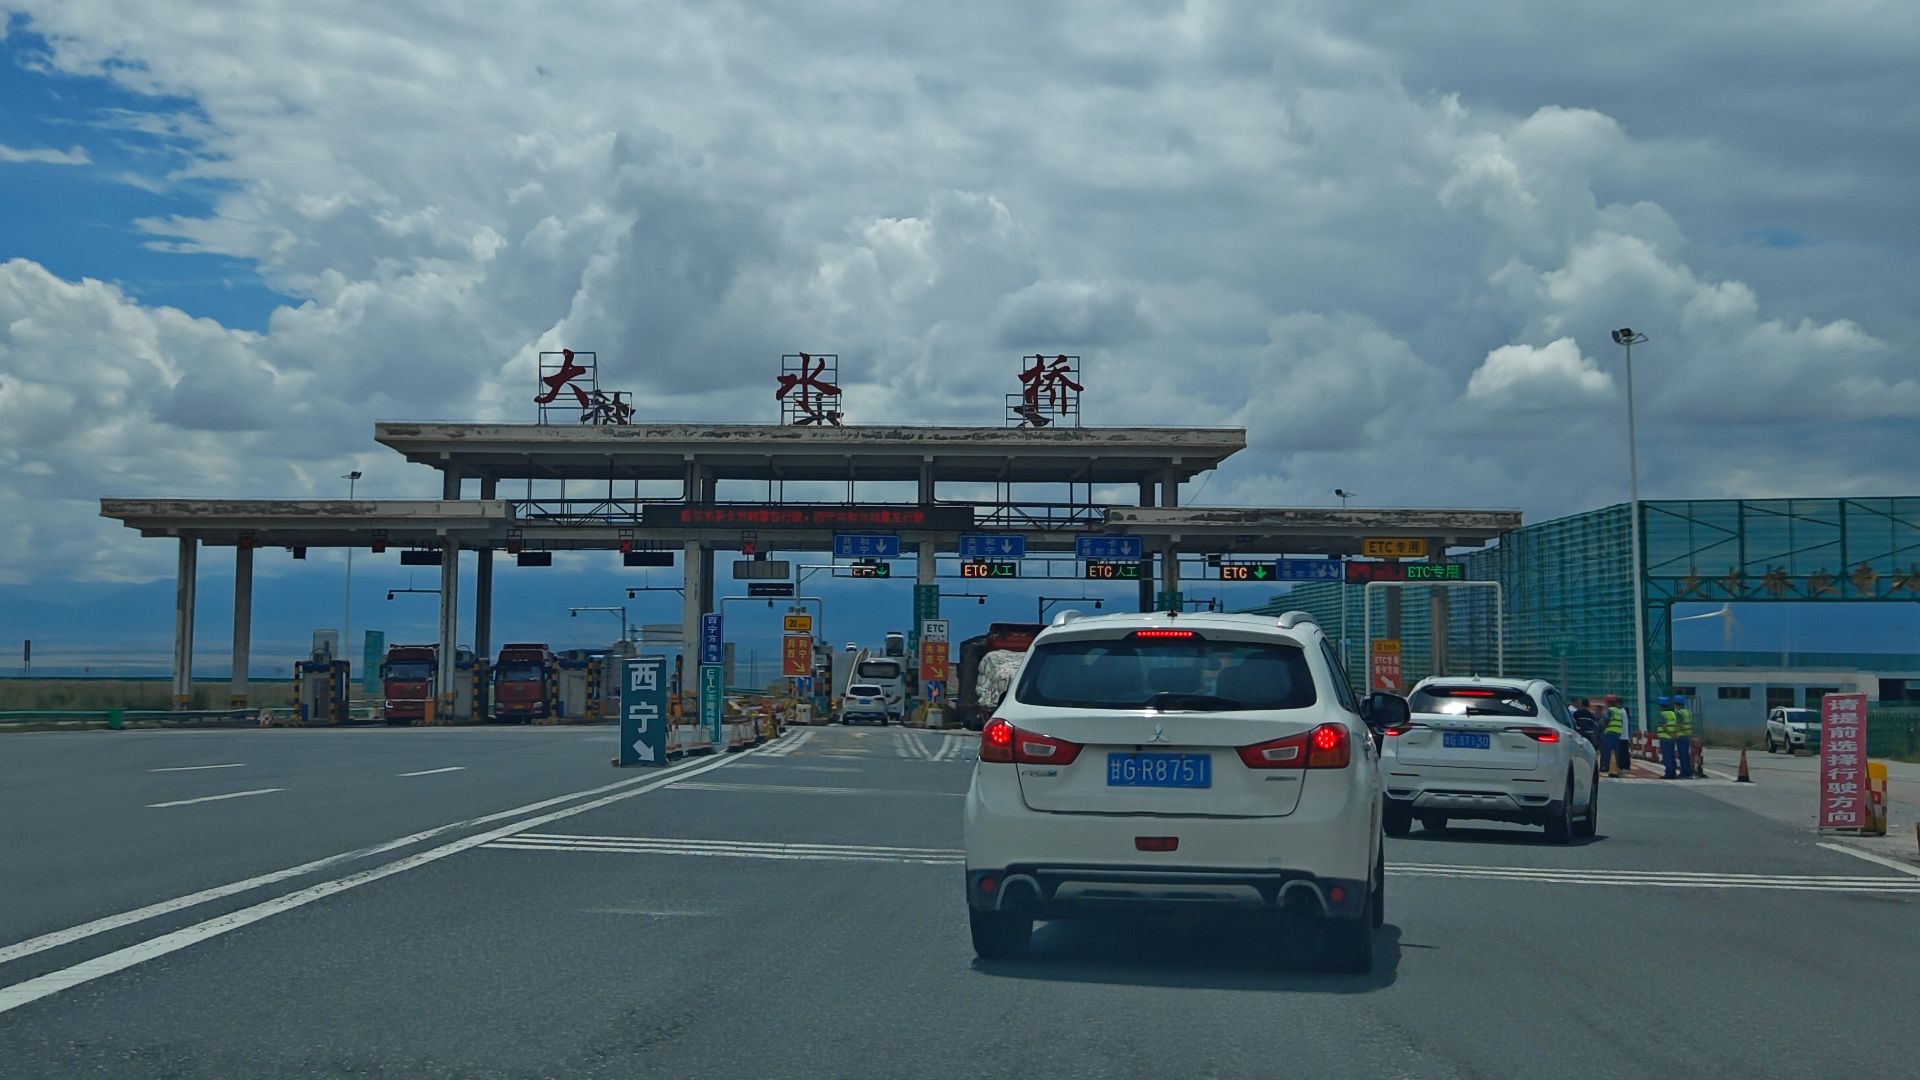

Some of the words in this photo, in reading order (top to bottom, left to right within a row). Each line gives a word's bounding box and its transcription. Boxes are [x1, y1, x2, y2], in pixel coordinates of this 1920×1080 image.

[964, 564, 988, 577] ETC
[990, 564, 1013, 576] 人工
[1089, 565, 1113, 578] ETC
[1115, 565, 1138, 577] 人工
[1223, 567, 1248, 579] ETC
[1407, 564, 1460, 579] ETC专用
[926, 623, 945, 633] ETC
[628, 663, 660, 734] 西宁
[1827, 698, 1859, 823] 请提前选择行驶方向
